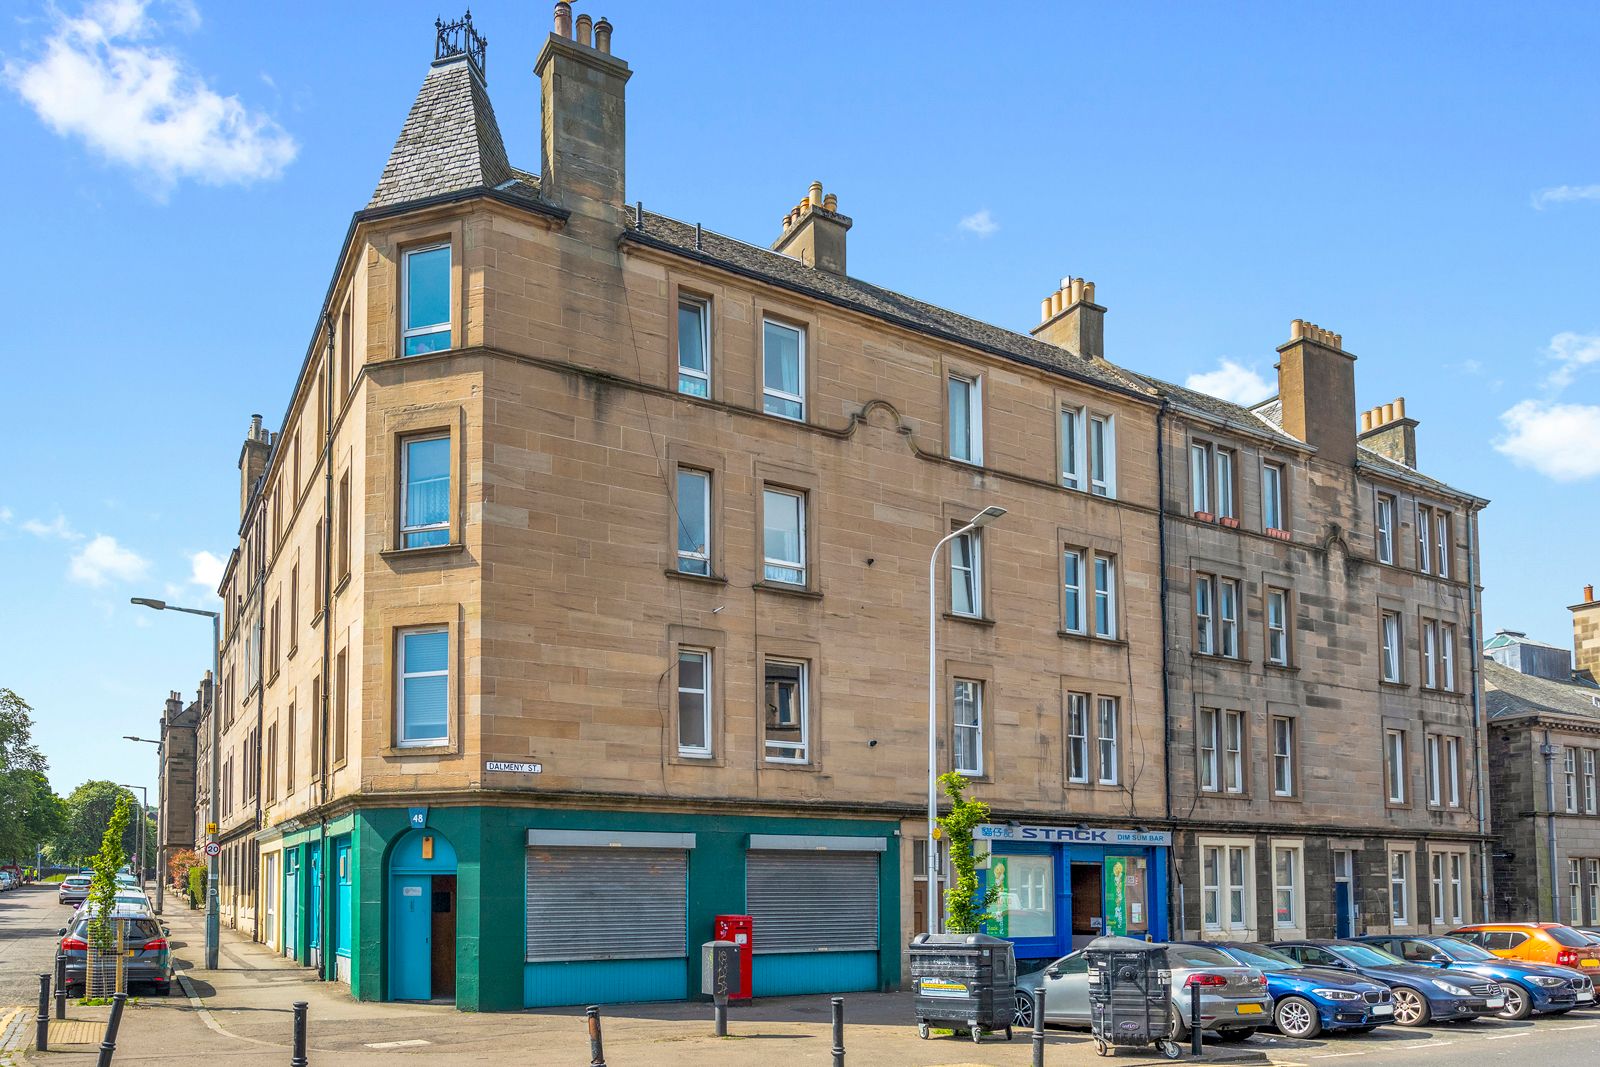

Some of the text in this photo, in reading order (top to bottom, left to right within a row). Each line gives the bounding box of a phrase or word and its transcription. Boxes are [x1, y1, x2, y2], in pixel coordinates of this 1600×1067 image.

[489, 762, 524, 771] DALMENY
[412, 814, 424, 823] 48
[1022, 828, 1107, 842] STACK
[1149, 834, 1164, 842] BAR
